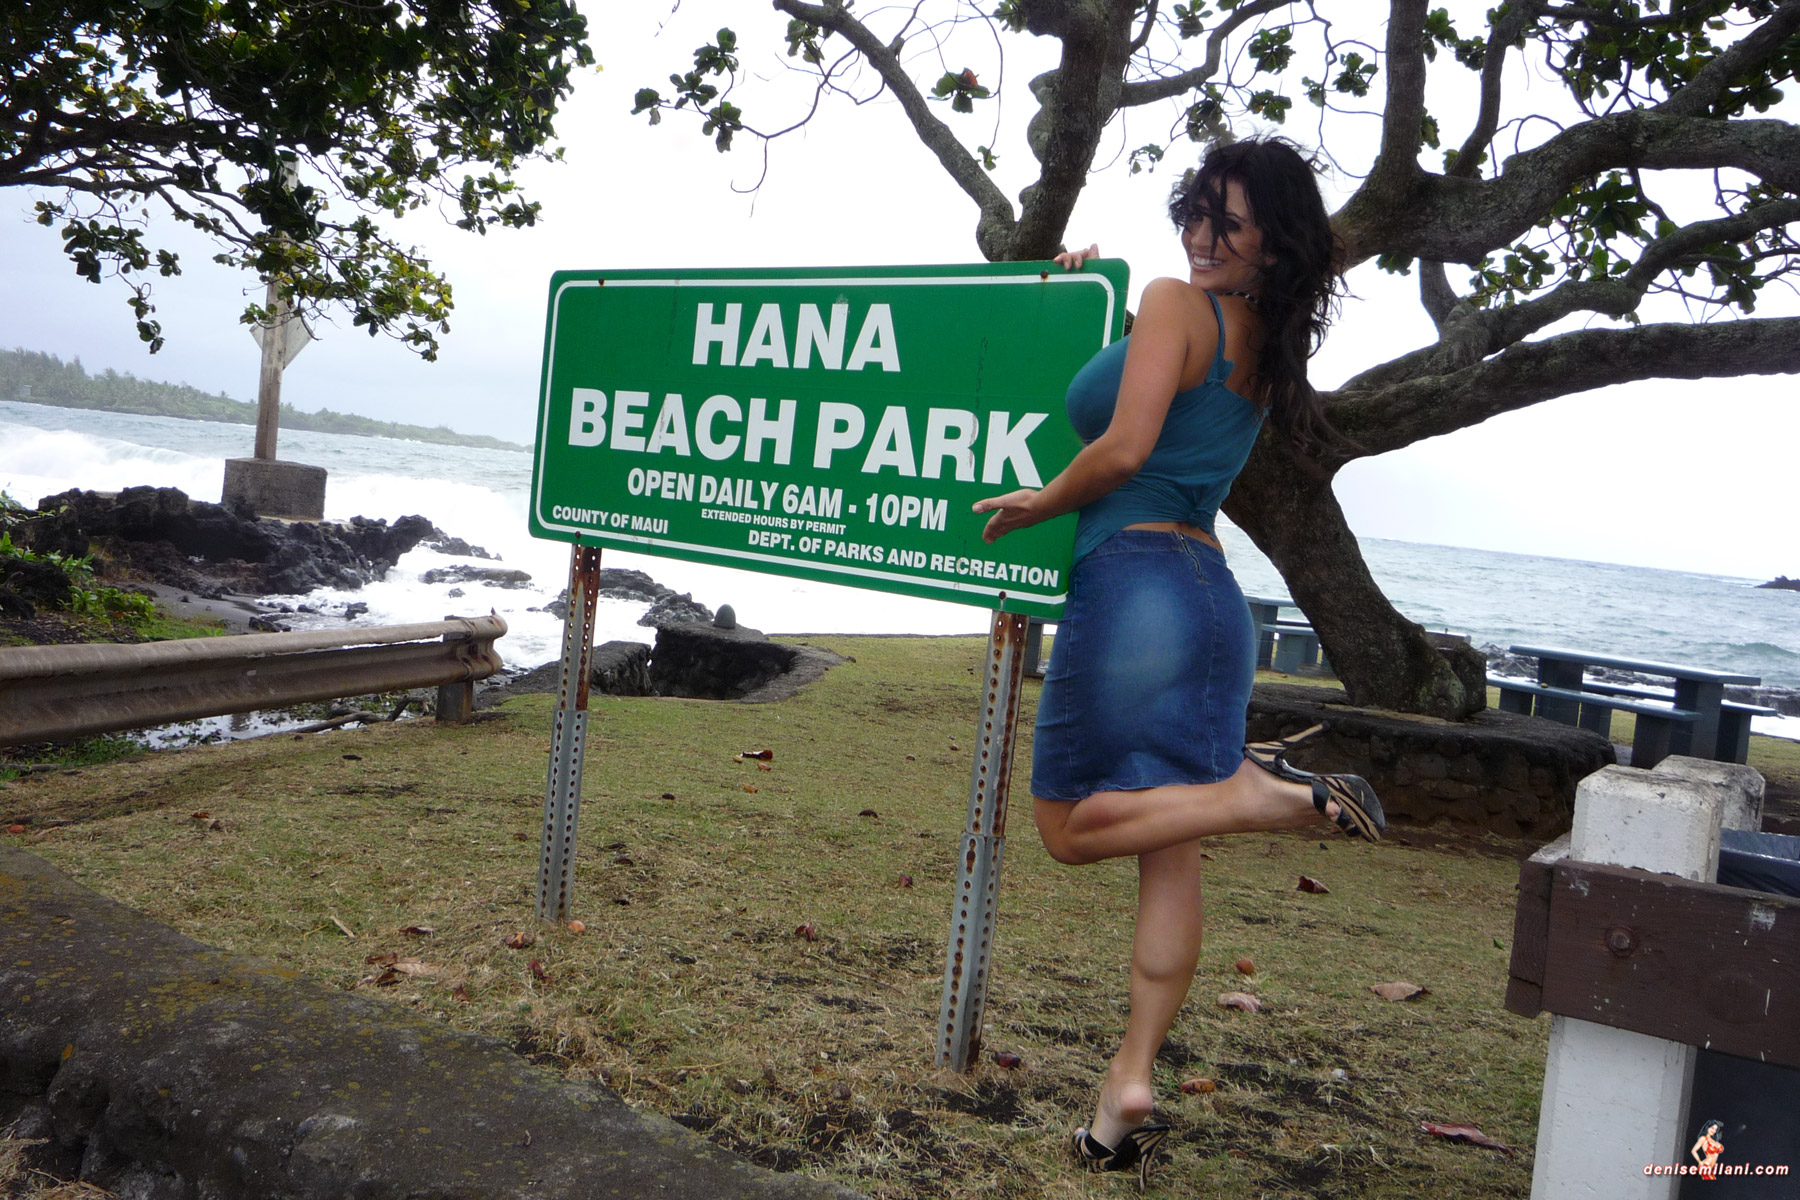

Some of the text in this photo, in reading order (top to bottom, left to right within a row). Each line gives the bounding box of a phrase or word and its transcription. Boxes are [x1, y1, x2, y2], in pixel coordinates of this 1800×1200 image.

[692, 302, 901, 372] HANA
[568, 387, 1050, 489] BEACH PARK
[551, 504, 669, 534] COUNTY OF MAUI
[627, 467, 948, 532] OPEN DAILY 6AM - 10PM
[701, 508, 847, 535] EXTENDED HOURS BY PERMIT
[748, 529, 1059, 588] DEPT. OF PARKS AND RECREATION
